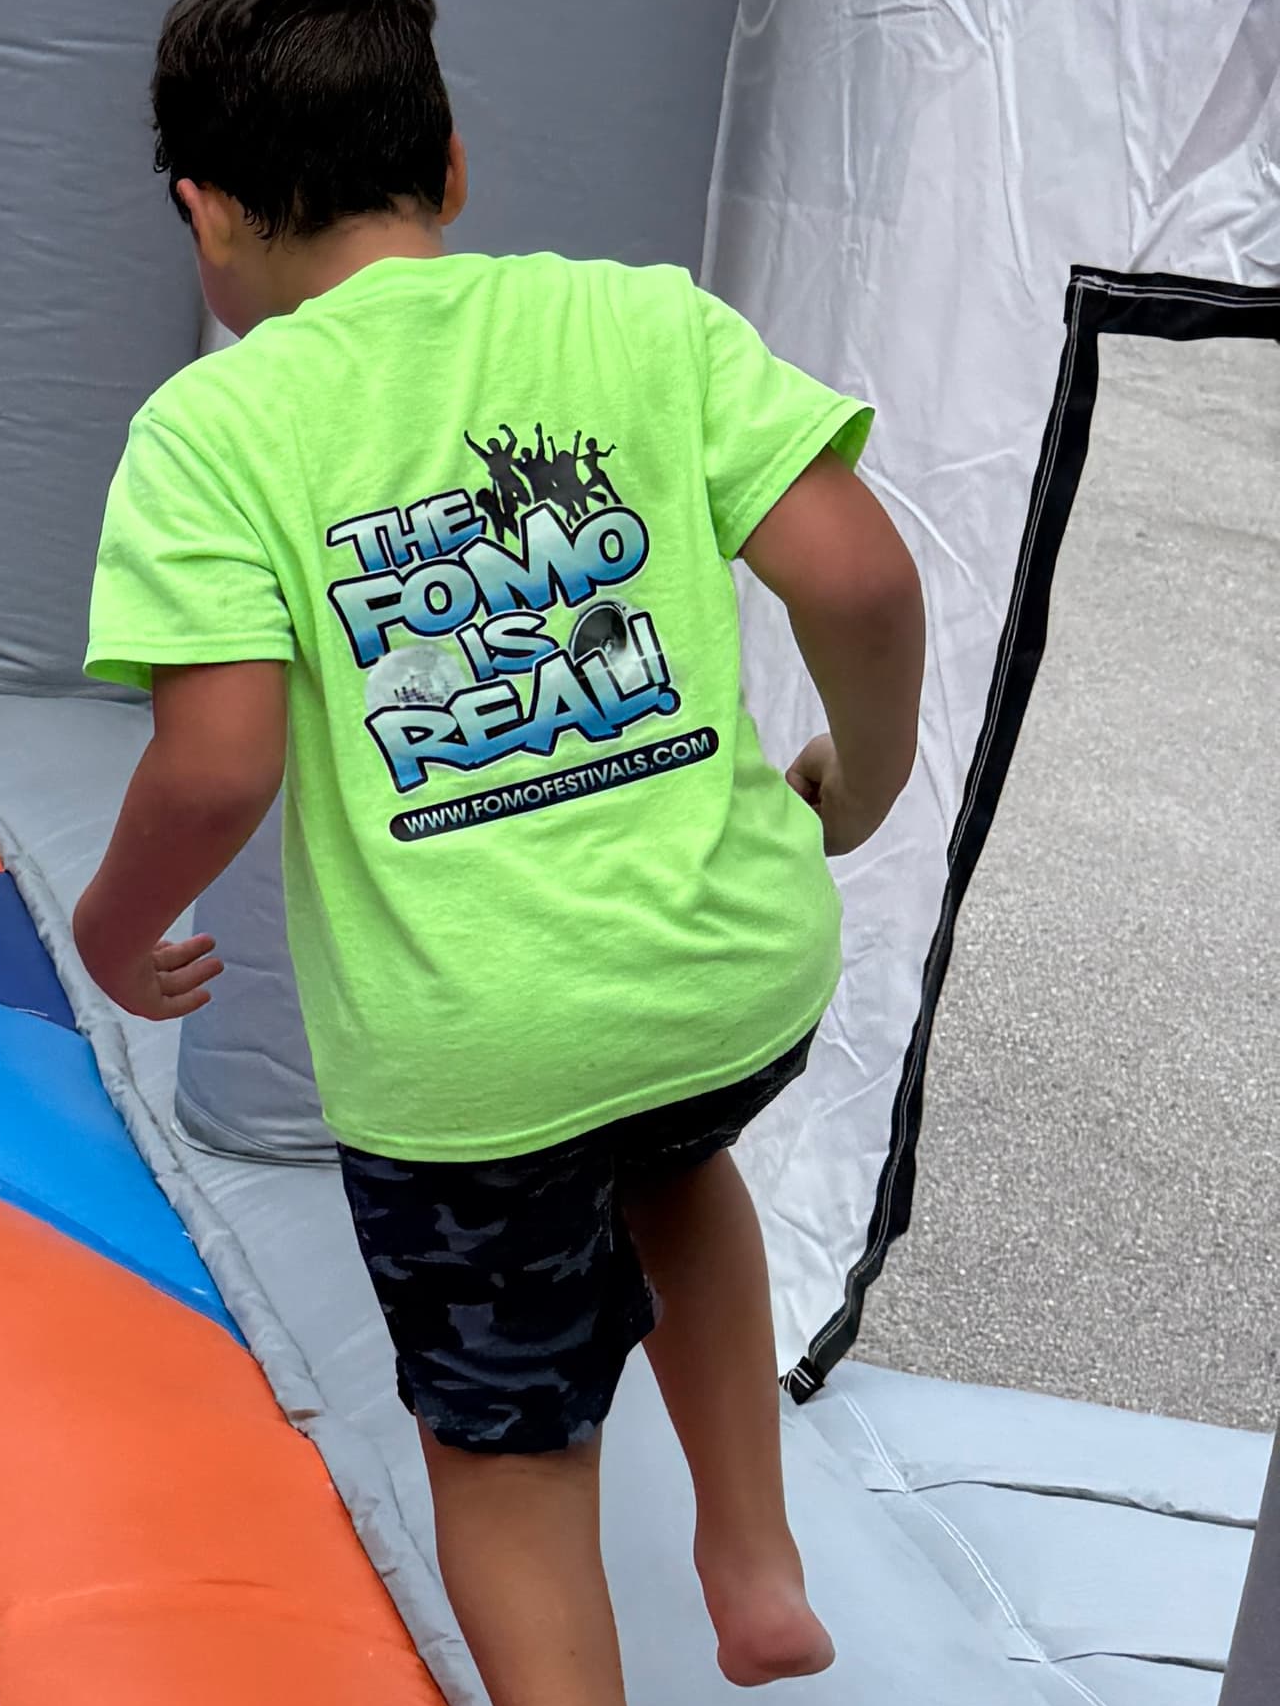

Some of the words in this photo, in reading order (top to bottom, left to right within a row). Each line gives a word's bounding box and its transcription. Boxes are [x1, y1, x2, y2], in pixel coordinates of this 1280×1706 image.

[327, 488, 487, 574] THE
[329, 501, 650, 669] FOMO
[456, 611, 558, 682] IS
[365, 611, 681, 793] REAL!
[403, 733, 710, 834] WWW.FOMOFESTIVALS.COM
